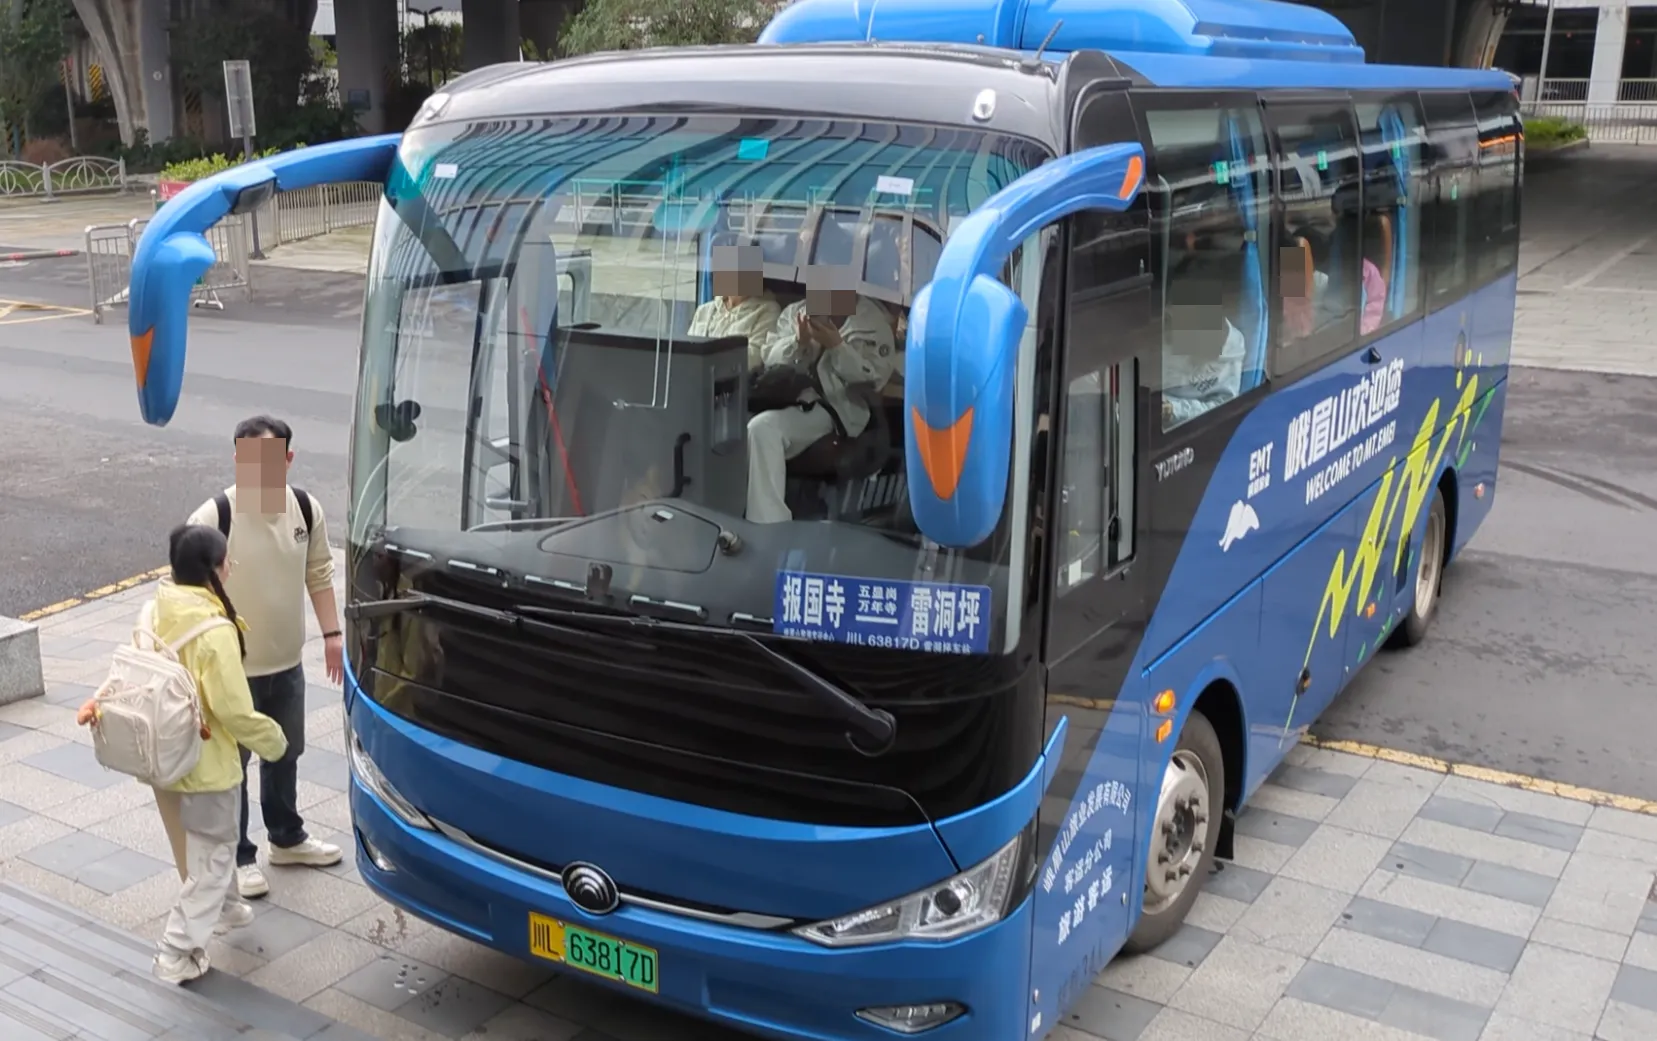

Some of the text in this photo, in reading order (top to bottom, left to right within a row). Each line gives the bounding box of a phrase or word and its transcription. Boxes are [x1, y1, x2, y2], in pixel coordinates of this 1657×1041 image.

[1284, 357, 1404, 482] 峨眉山欢迎您
[1249, 441, 1273, 481] EMT
[1306, 450, 1352, 506] WELCOME
[1352, 442, 1364, 472] TO
[783, 575, 846, 629] 报国寺
[858, 599, 898, 616] 万年寺
[911, 587, 981, 640] 雷洞坪
[846, 631, 866, 646] 川L
[868, 634, 920, 651] 63817D
[533, 921, 654, 985] 川L 63817D
